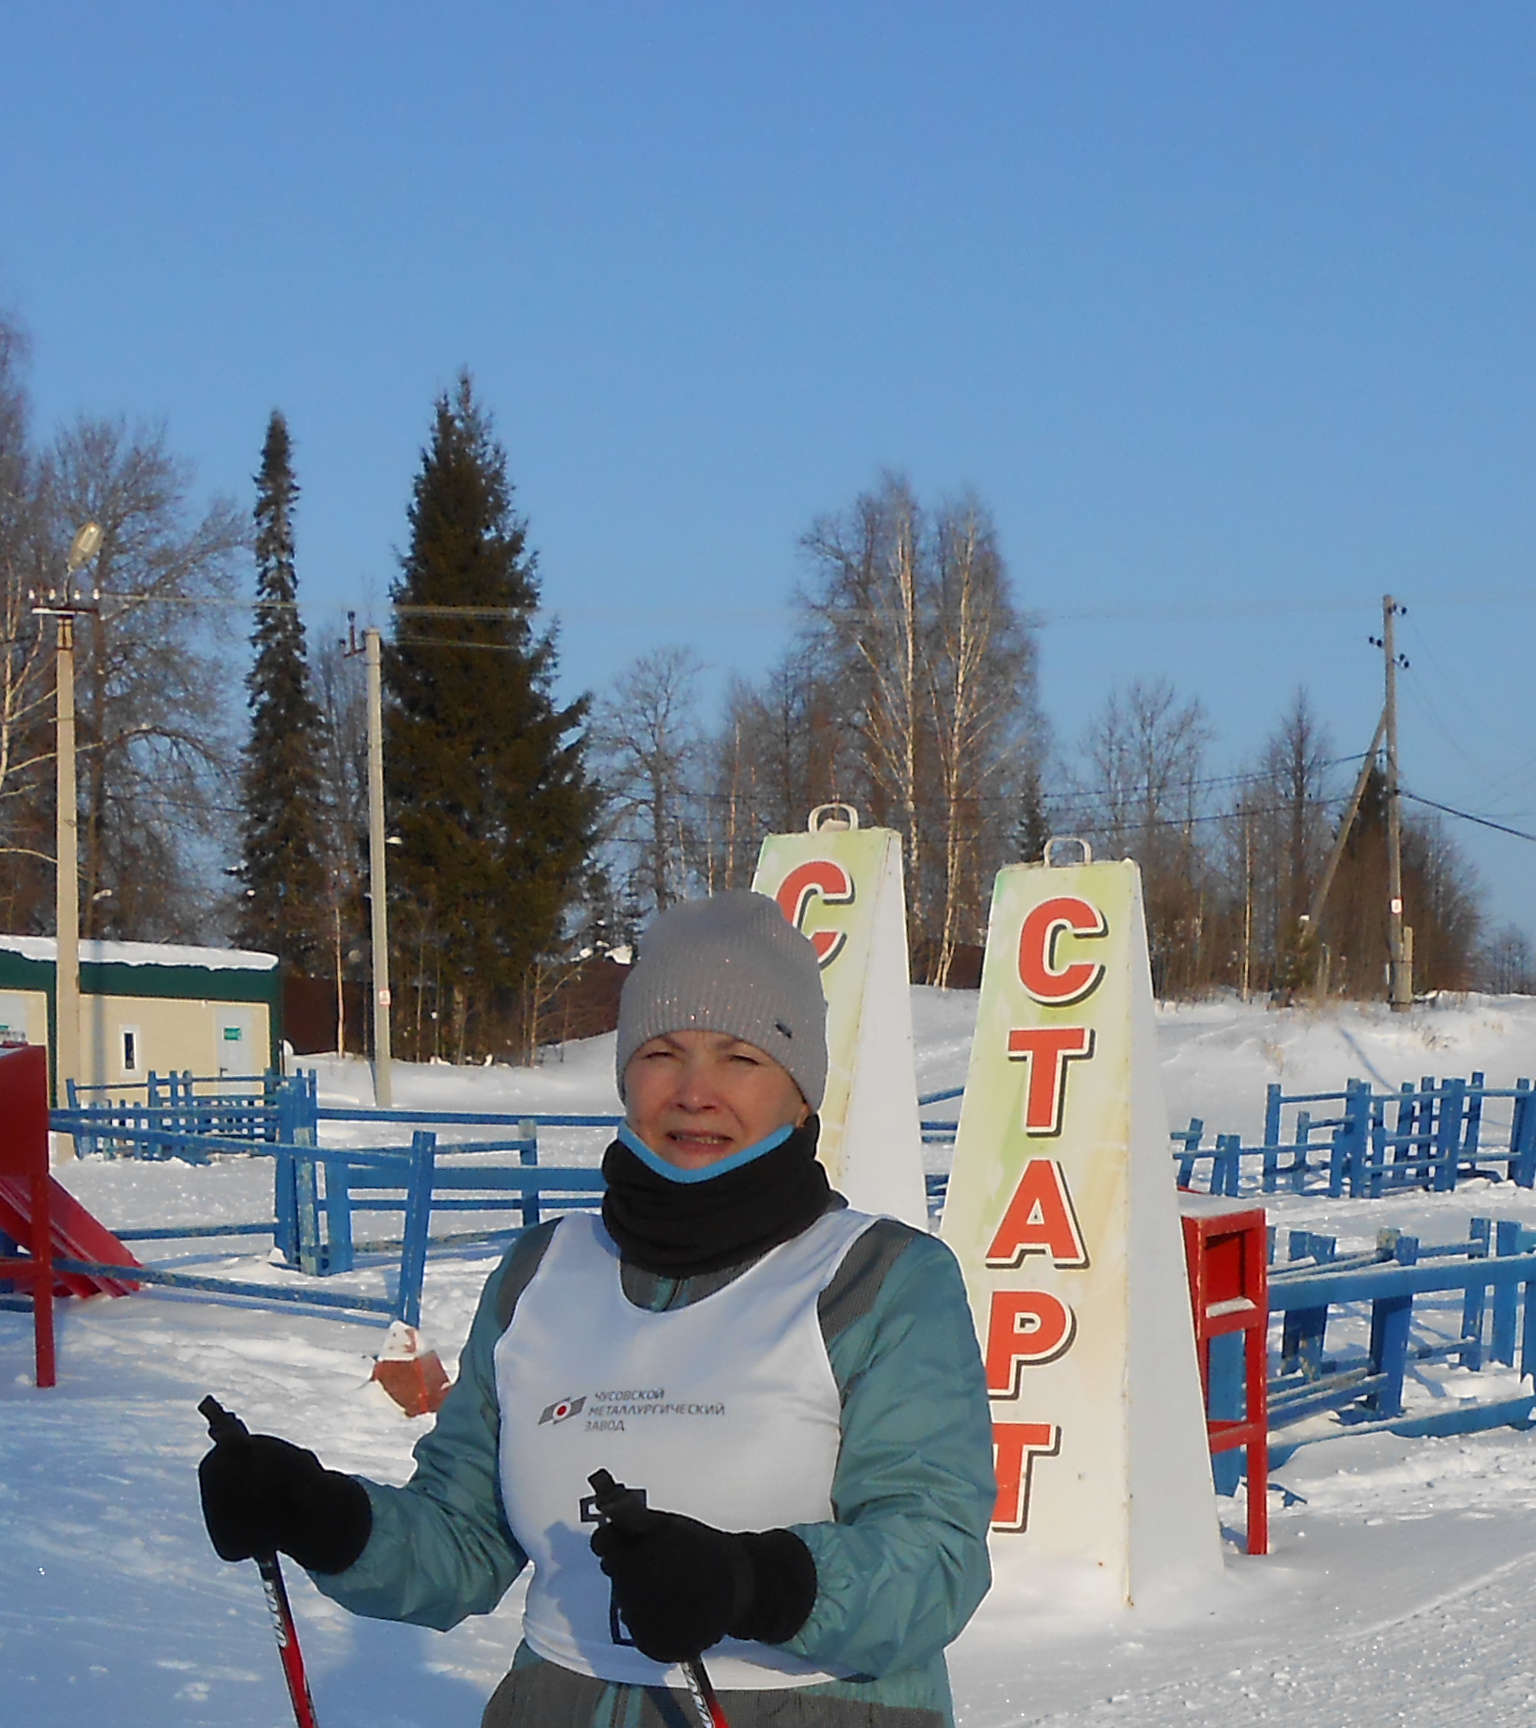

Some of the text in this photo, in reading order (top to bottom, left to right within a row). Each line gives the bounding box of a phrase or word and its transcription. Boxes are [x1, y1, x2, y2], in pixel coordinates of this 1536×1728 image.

[985, 896, 1109, 1534] СТАРТ
[595, 1388, 664, 1401] ЧУСОВСКОЙ
[588, 1402, 725, 1416] МЕТАЛЛУРГИЧЕСКИЙ
[584, 1420, 625, 1432] ЗАВОД
